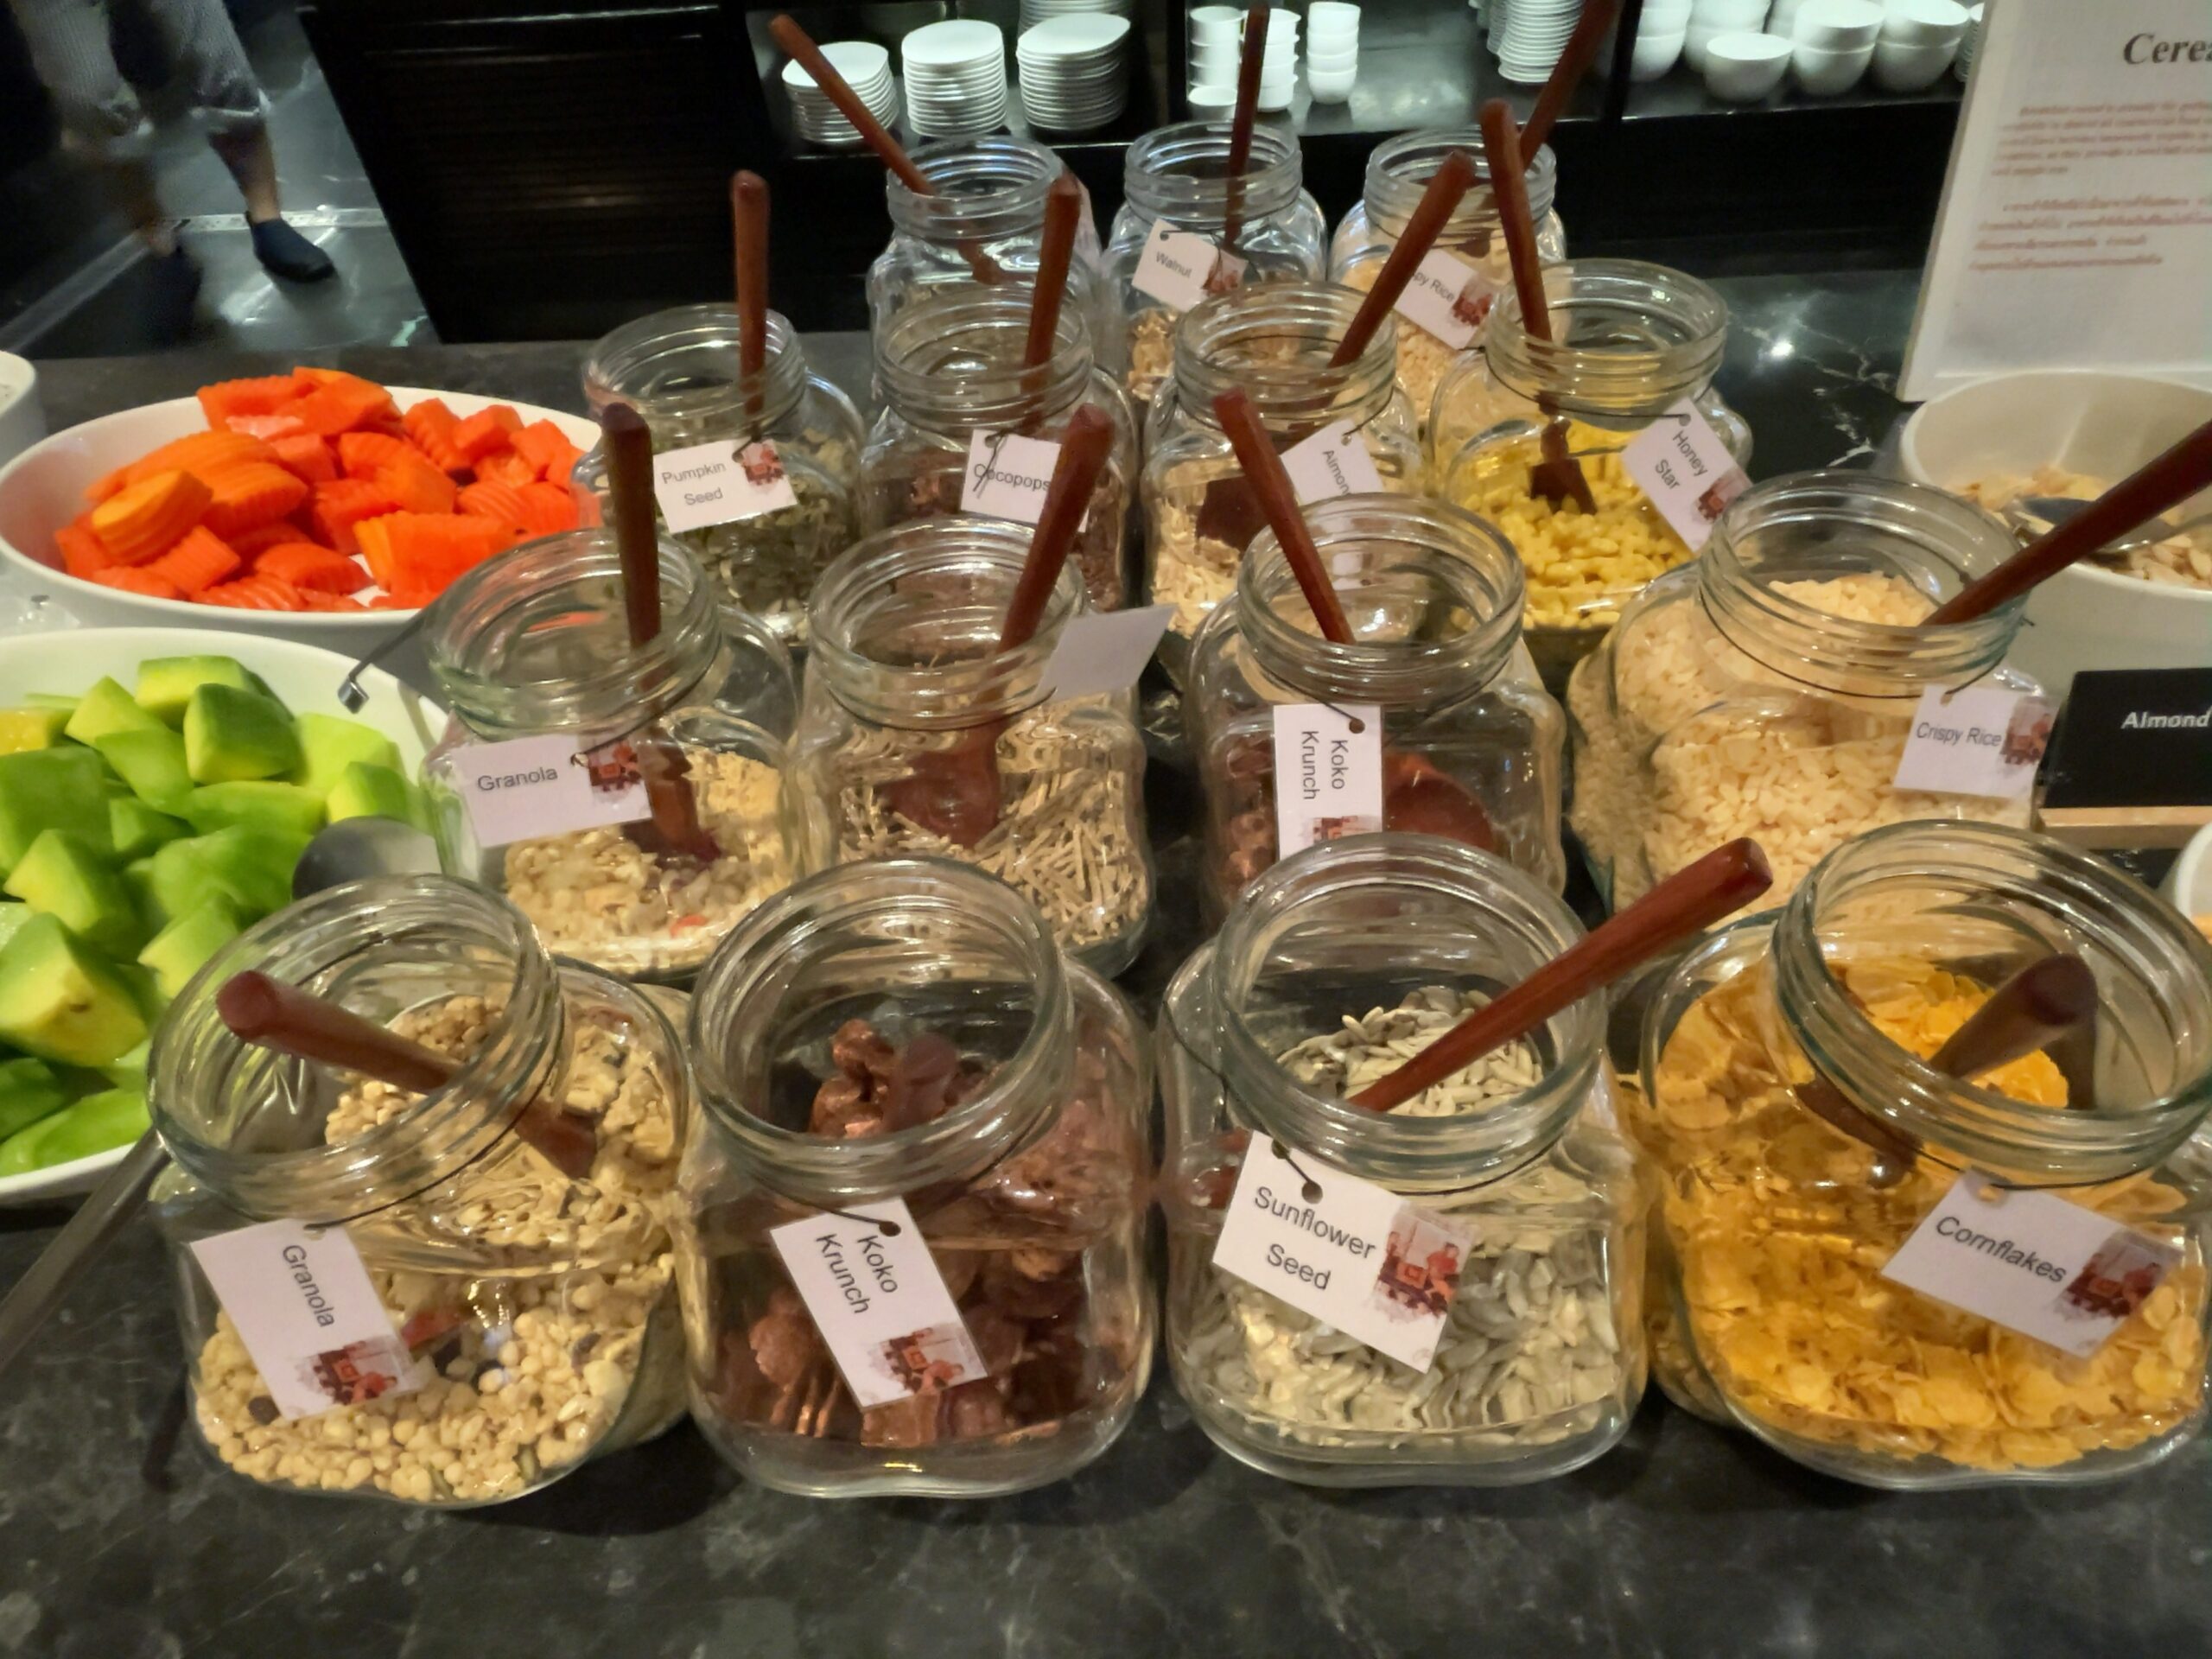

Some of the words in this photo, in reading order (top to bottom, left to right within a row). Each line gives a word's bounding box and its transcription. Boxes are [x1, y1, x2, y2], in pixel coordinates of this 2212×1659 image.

[1155, 251, 1192, 278] Walnut
[1429, 278, 1455, 302] Rice
[661, 461, 727, 485] Pumpkin
[1322, 448, 1351, 495] Almon
[1654, 458, 1681, 490] Star
[1672, 430, 1708, 477] Honey
[683, 486, 724, 505] Seed
[974, 463, 1052, 492] Cocopops
[1916, 721, 1963, 746] Crispy
[1966, 728, 2002, 747] Rice
[2120, 705, 2212, 729] Almond
[478, 766, 558, 791] Granola
[1301, 730, 1320, 800] Krunch
[1331, 740, 1350, 790] Koko
[1255, 1185, 1376, 1259] Sunflower
[816, 1233, 871, 1314] Krunch
[857, 1234, 899, 1294] Koko
[1267, 1243, 1332, 1290] Seed
[1936, 1216, 2067, 1284] Cornflakes
[283, 1244, 335, 1328] Granola
